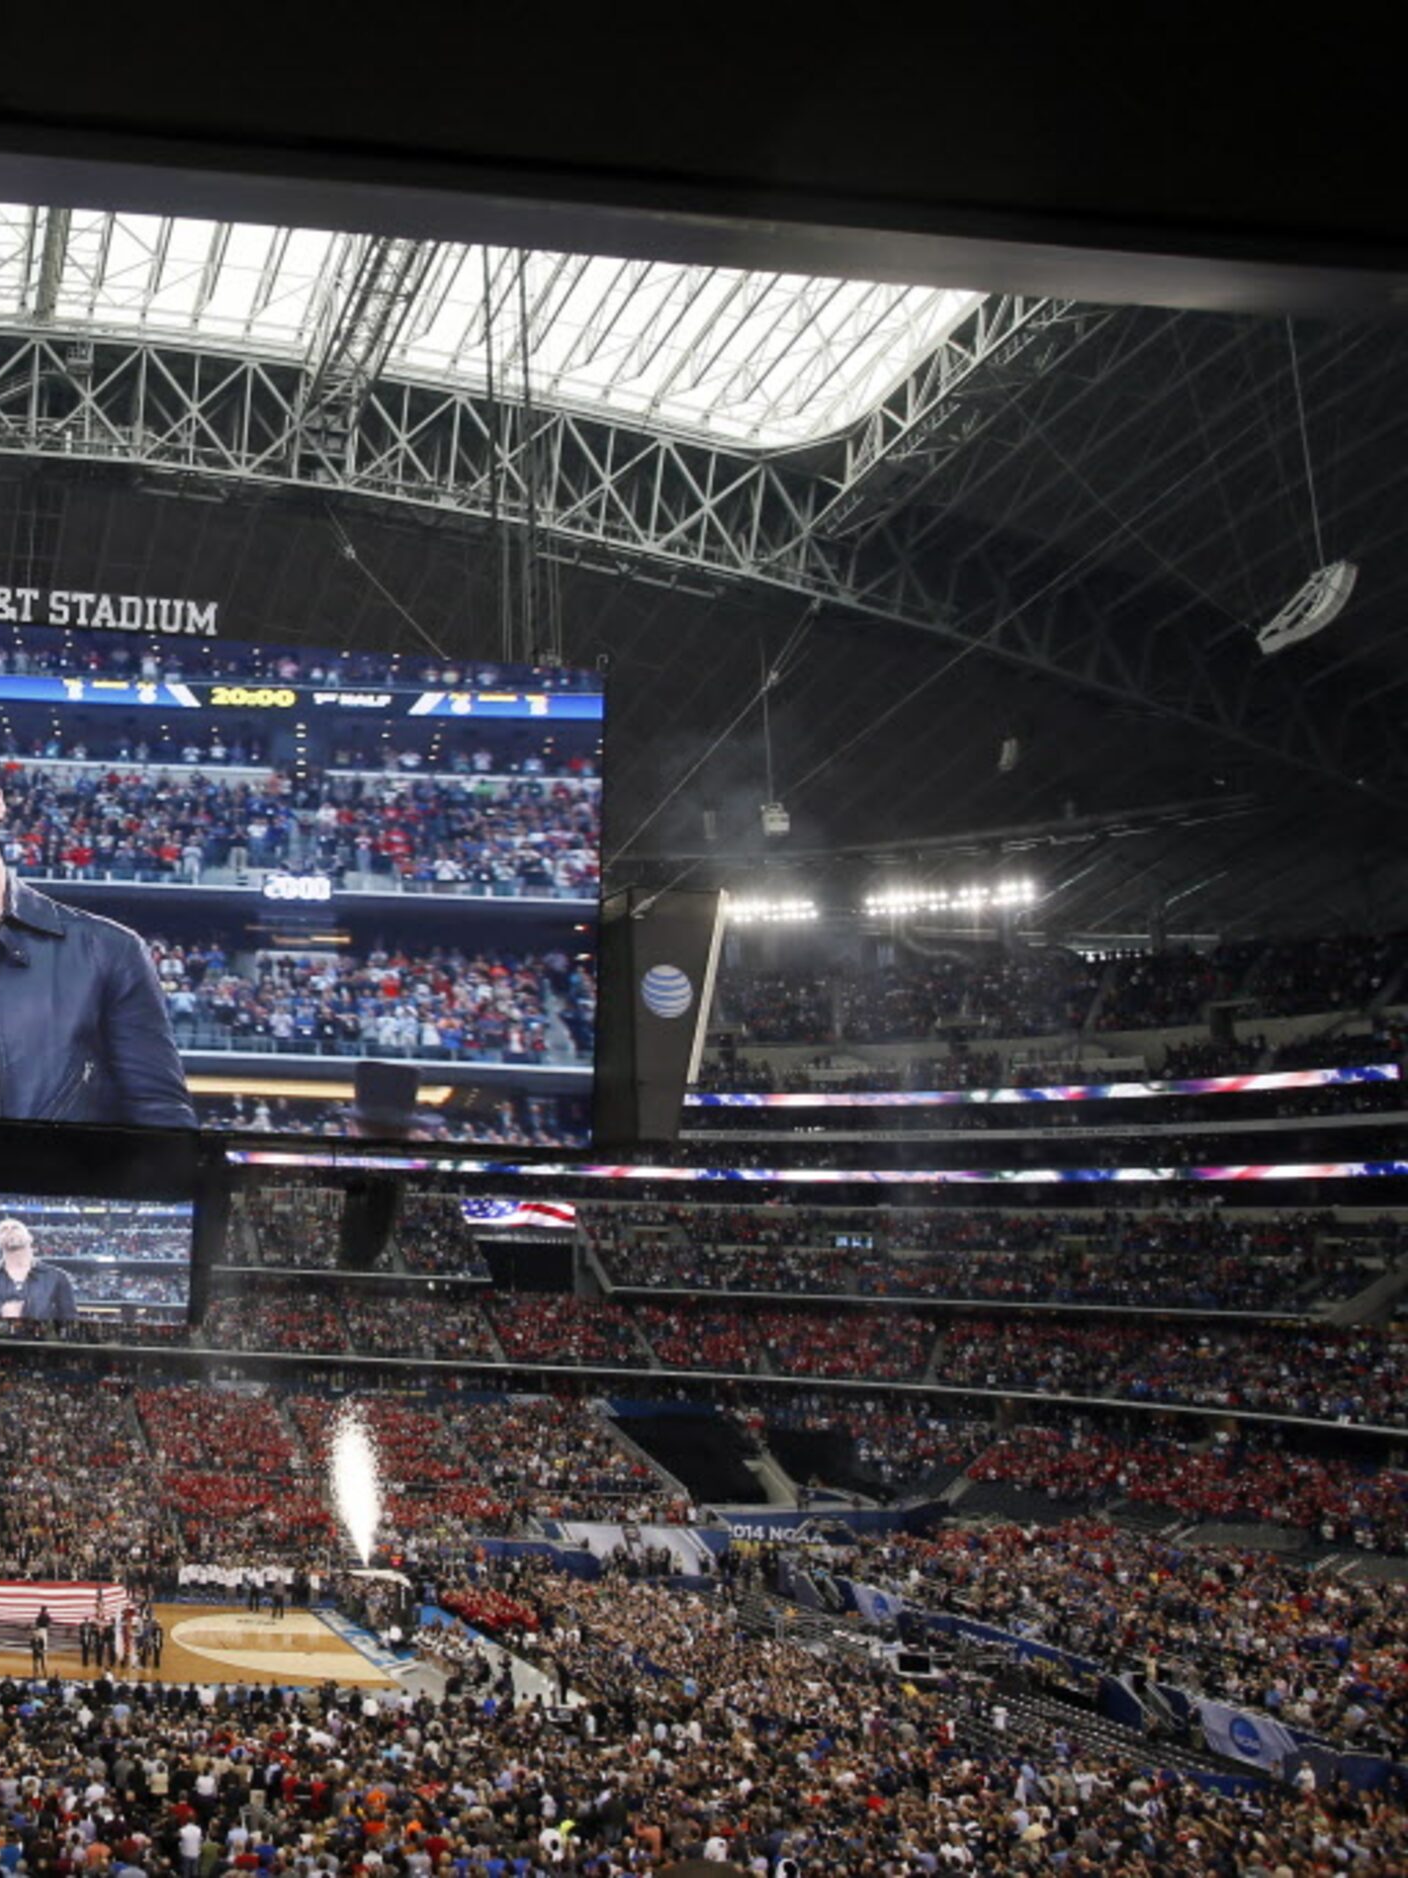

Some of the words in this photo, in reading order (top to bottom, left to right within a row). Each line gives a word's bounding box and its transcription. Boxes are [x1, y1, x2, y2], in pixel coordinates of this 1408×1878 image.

[48, 590, 219, 636] STADIUM
[210, 687, 296, 707] 20:00
[729, 1524, 765, 1541] 014
